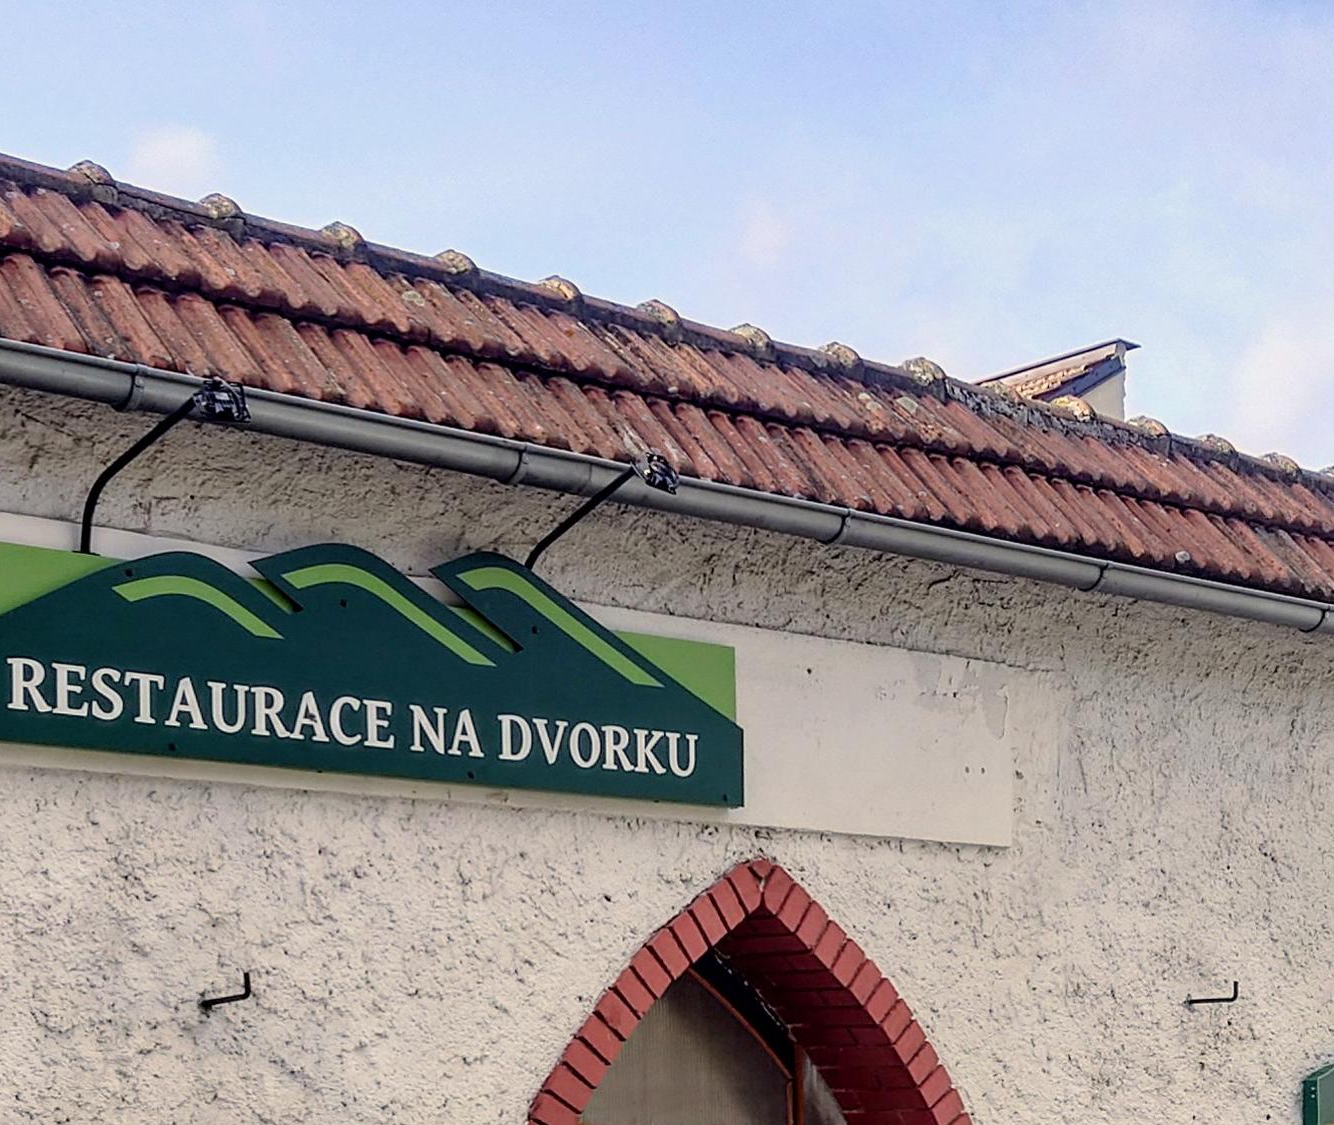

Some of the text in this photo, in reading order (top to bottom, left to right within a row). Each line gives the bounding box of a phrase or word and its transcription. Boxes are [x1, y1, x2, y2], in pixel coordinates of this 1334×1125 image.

[6, 657, 699, 778] RESTAURACE NA DVORKU
